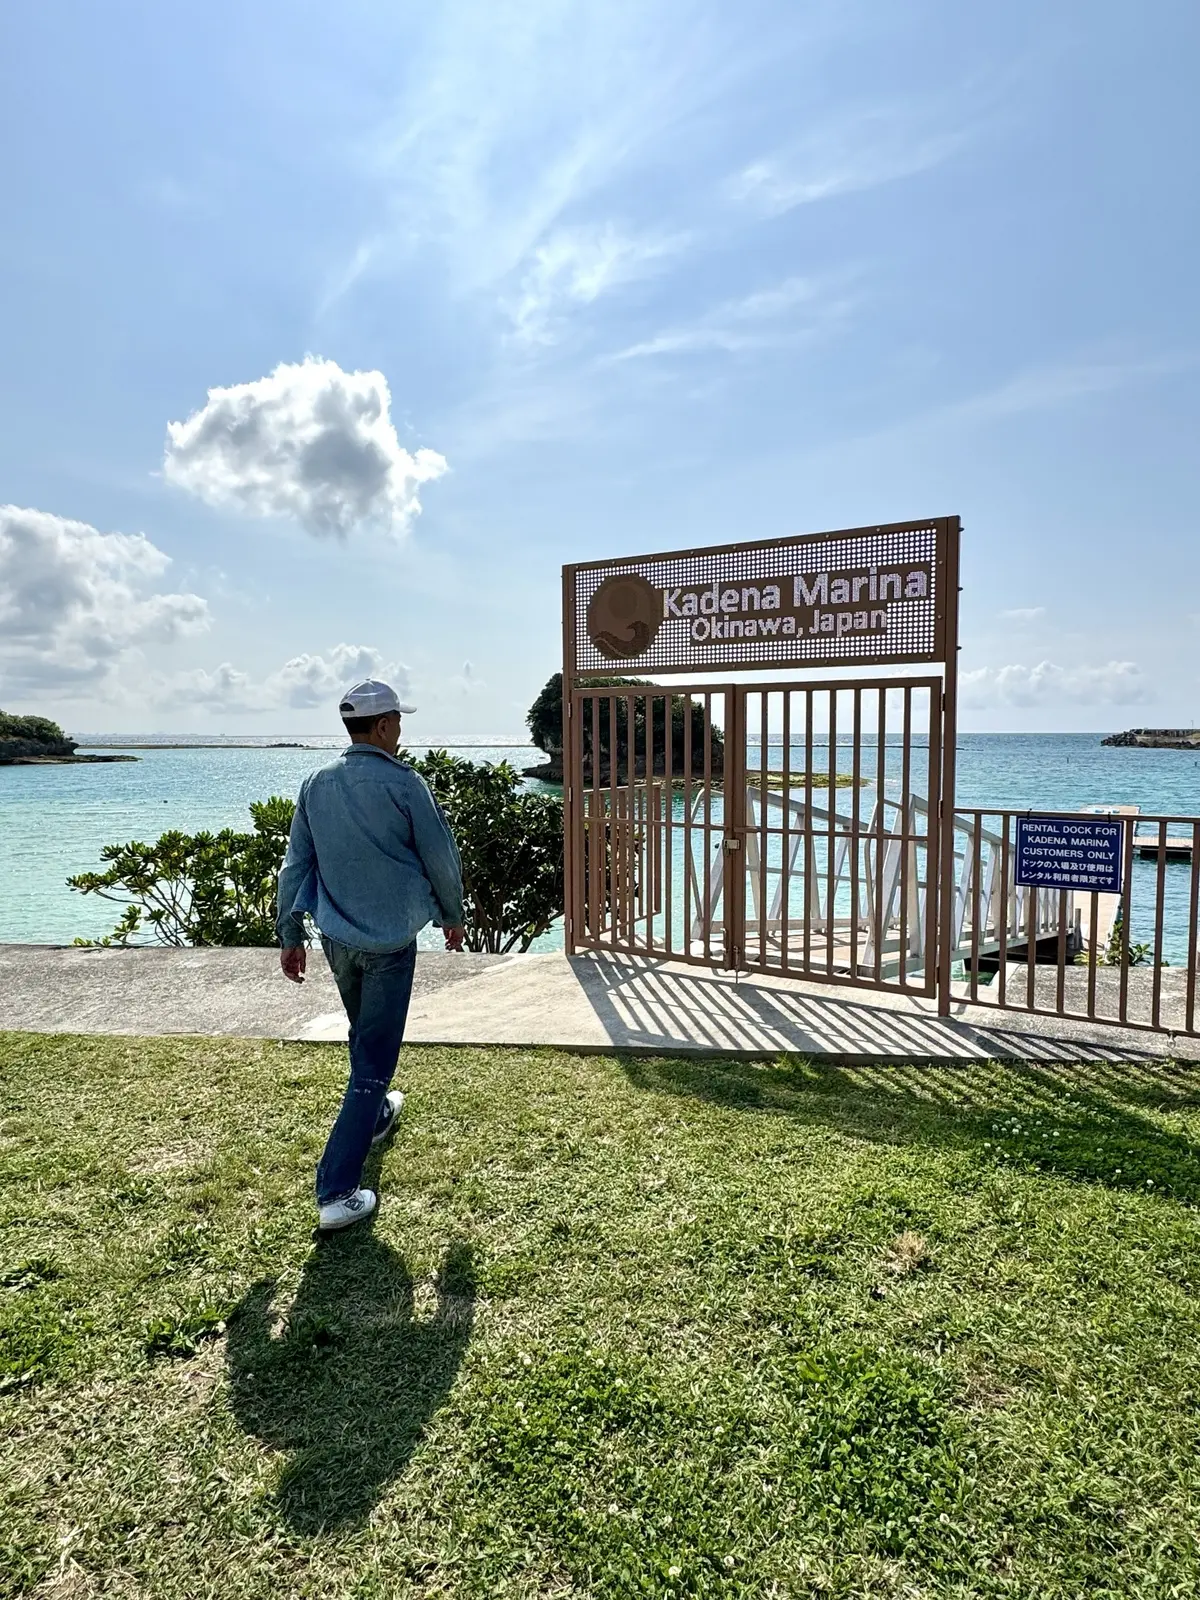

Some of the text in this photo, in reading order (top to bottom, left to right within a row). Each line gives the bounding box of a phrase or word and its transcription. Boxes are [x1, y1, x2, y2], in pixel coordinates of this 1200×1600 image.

[662, 566, 928, 618] Kadena Marina
[691, 608, 888, 641] Okinawa, Japan
[1022, 824, 1117, 836] RENTAL DOCK FOR
[1028, 836, 1110, 847] KADENA MARINA
[1022, 847, 1115, 860] CUSTOMERS ONLY
[1022, 859, 1114, 873] ドックの入場及び使用は
[1021, 871, 1115, 885] レンタル利用者限定です
